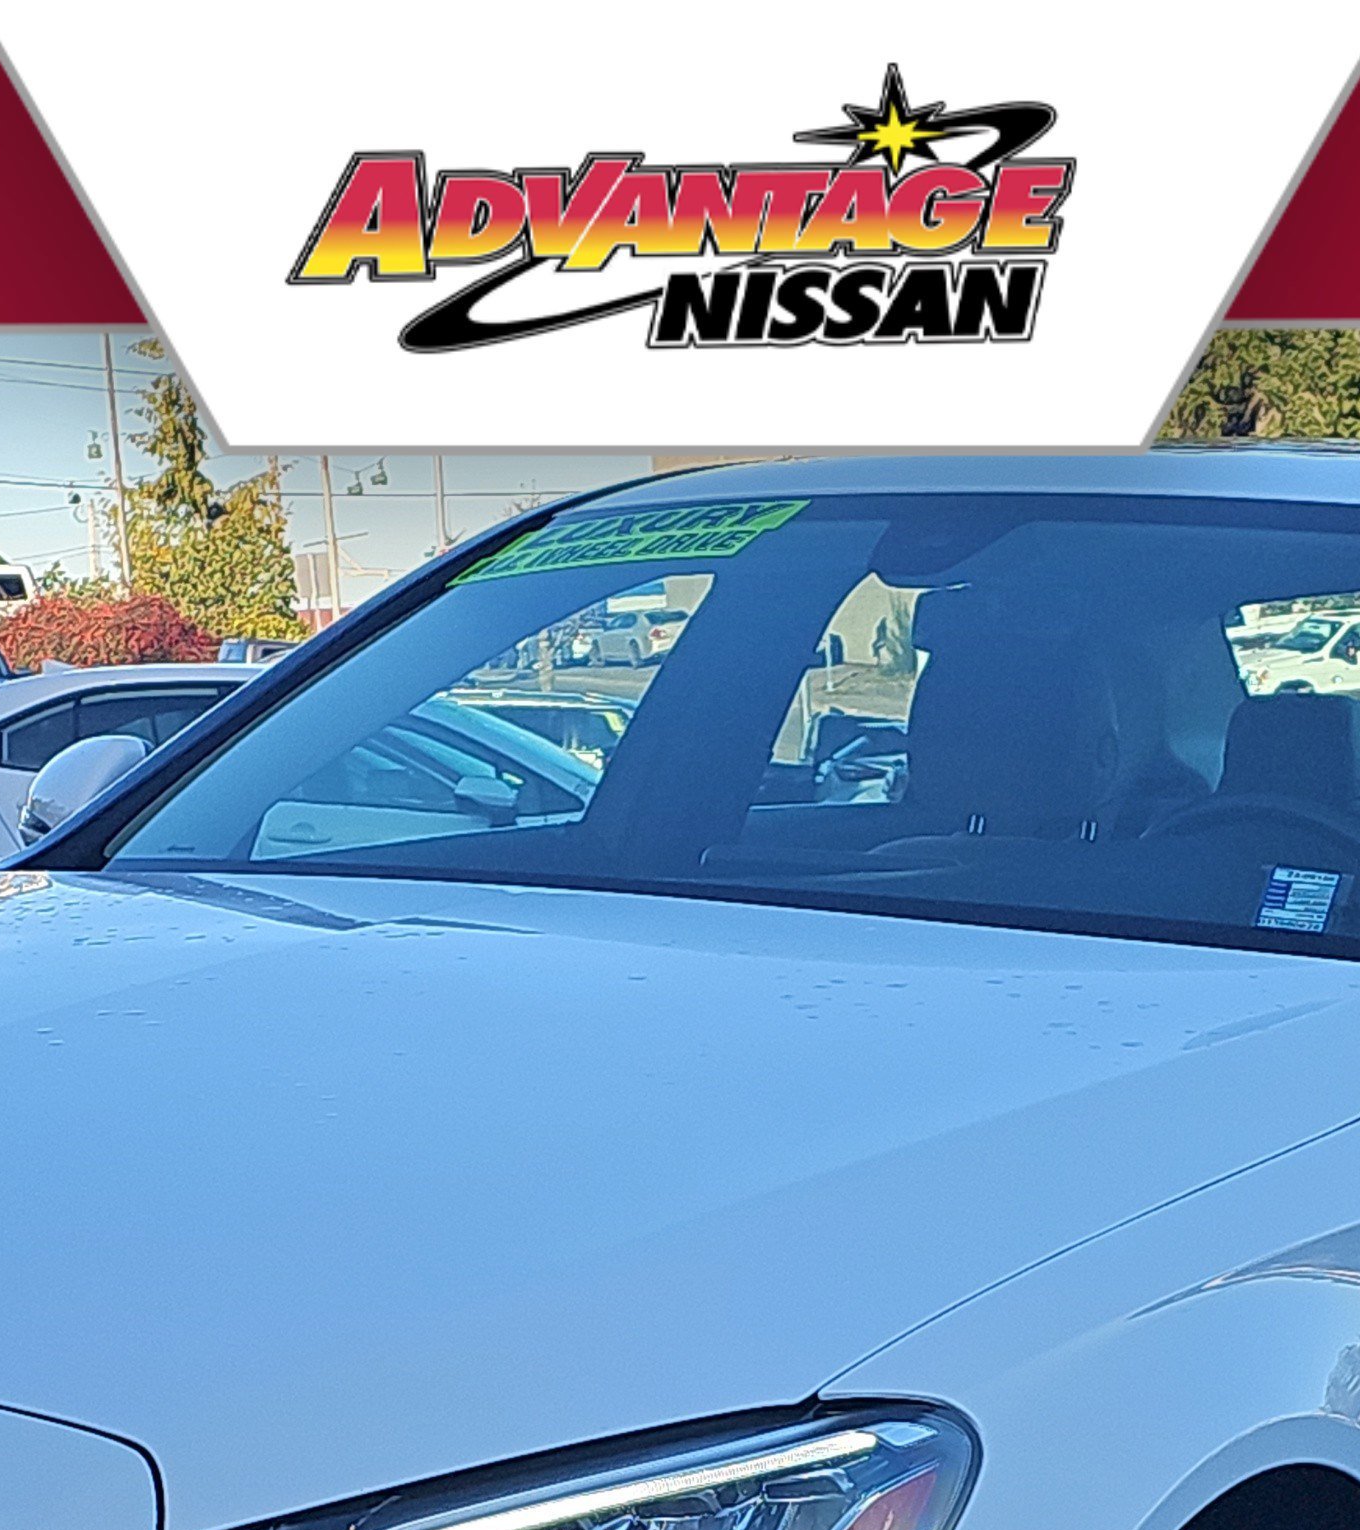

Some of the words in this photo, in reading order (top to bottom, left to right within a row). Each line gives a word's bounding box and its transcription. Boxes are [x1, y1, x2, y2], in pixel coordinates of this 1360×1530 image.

[518, 502, 800, 552] LUXURY
[522, 537, 643, 570] WHEEL
[636, 530, 752, 557] DRIVE
